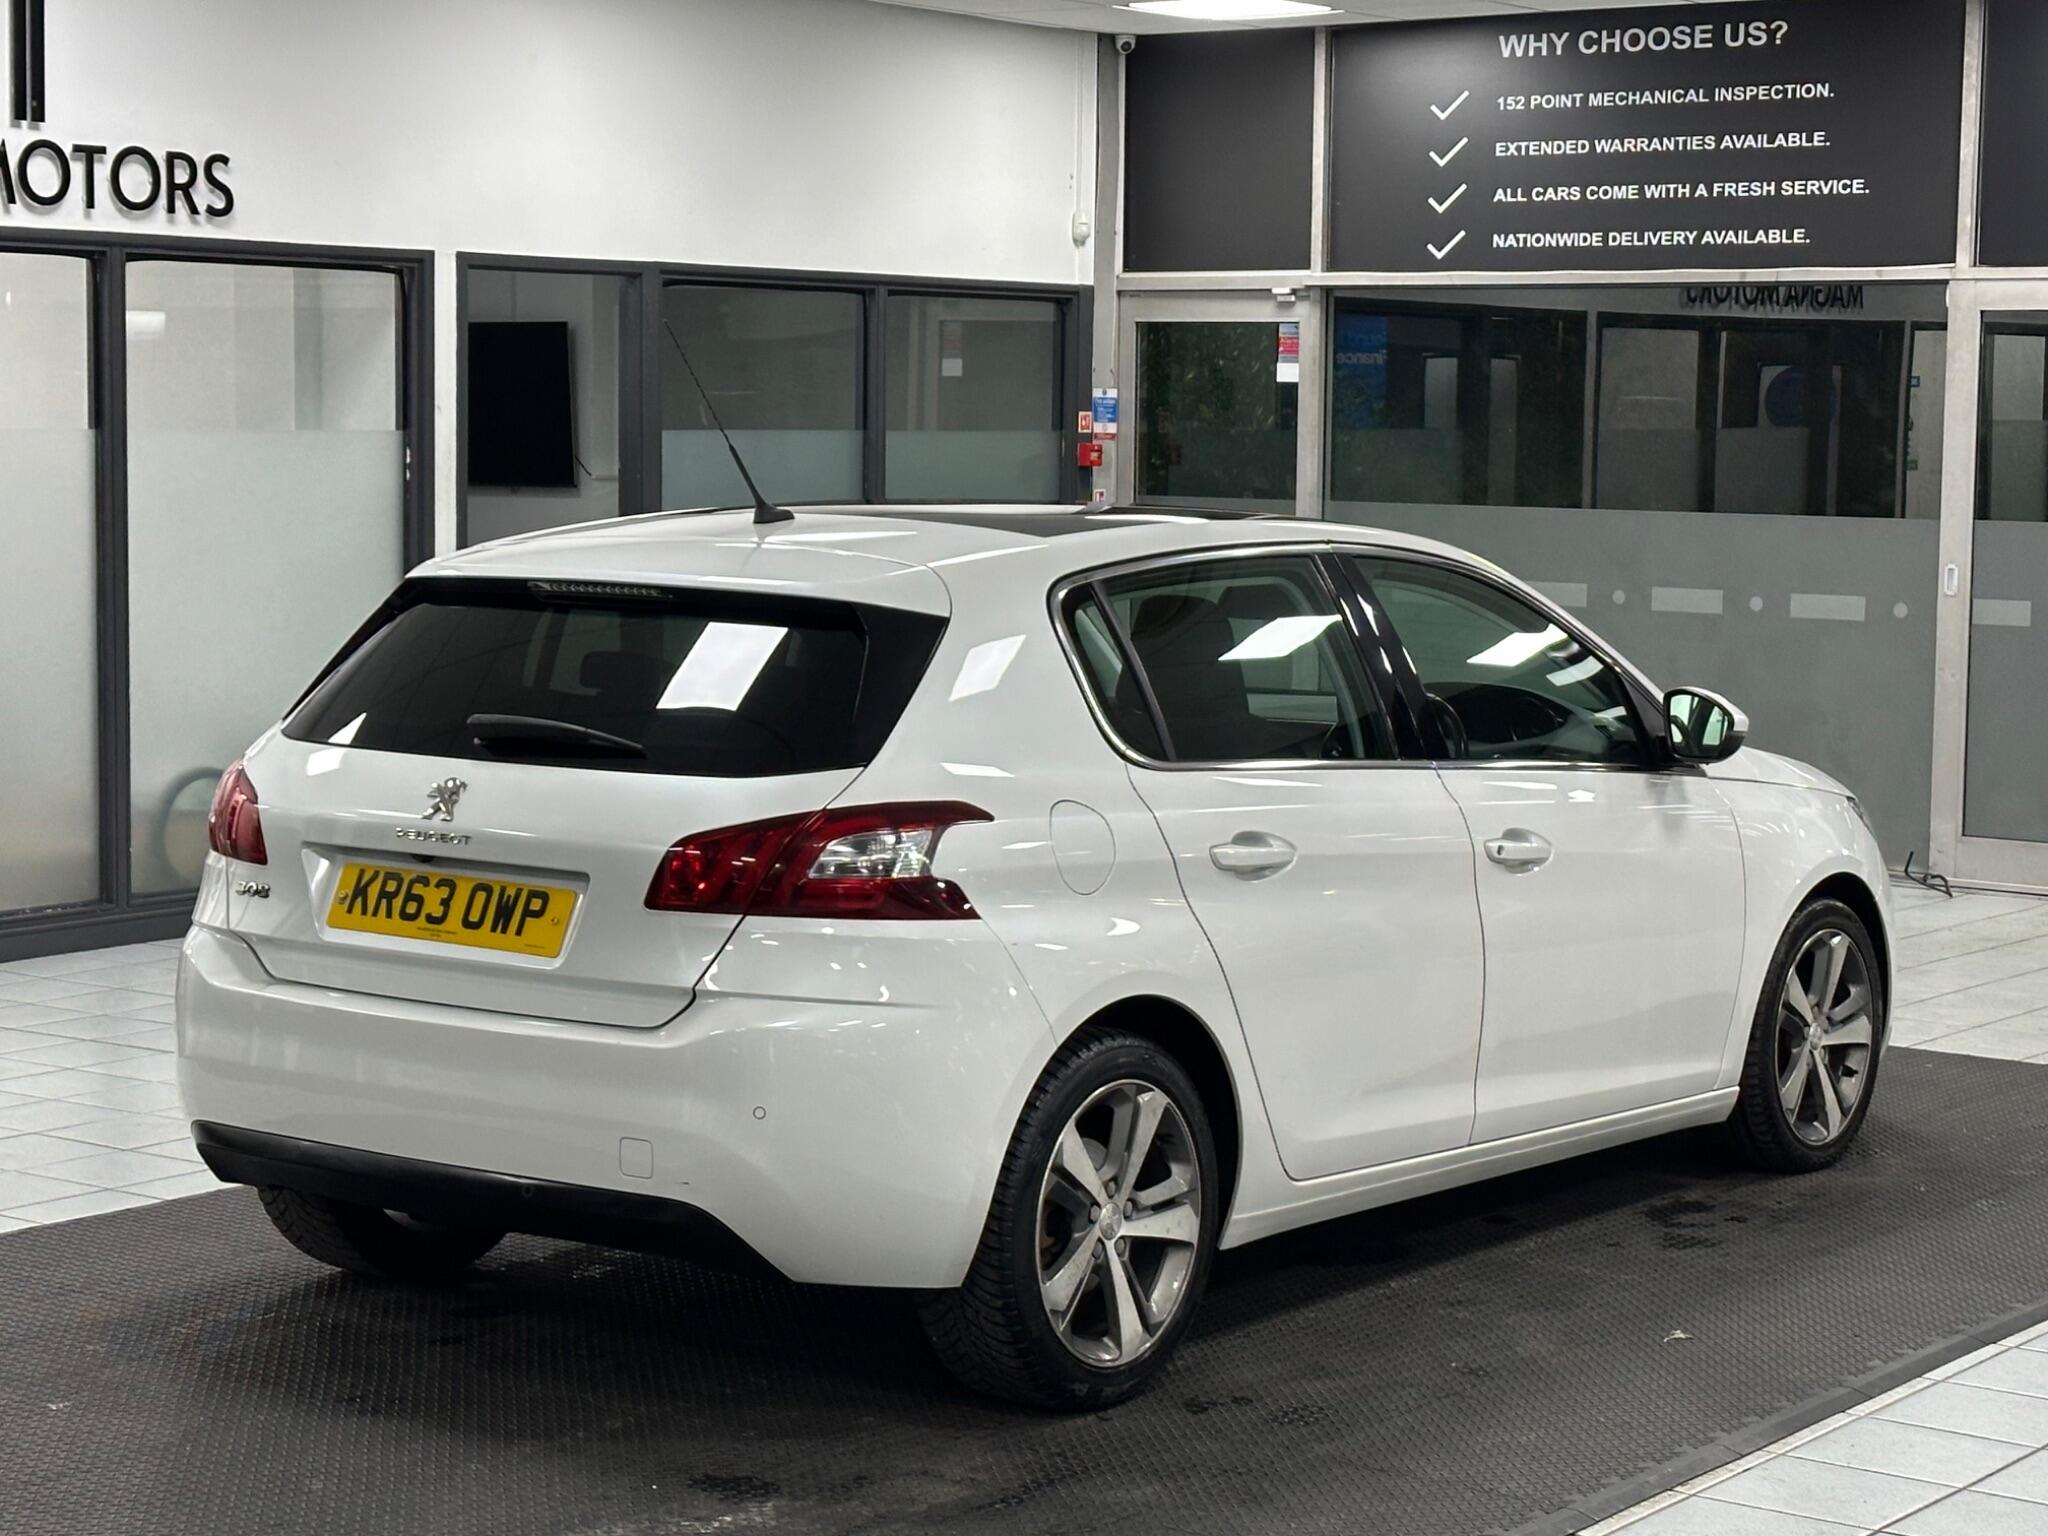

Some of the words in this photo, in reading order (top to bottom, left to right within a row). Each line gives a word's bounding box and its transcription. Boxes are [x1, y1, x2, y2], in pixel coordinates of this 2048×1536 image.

[1499, 32, 1571, 58] WHY
[1578, 24, 1713, 55] CHOOSE
[1724, 20, 1788, 47] US?
[1497, 96, 1525, 111] 152
[1530, 93, 1584, 110] POINT
[1588, 89, 1710, 108] MECHANICAL
[1714, 83, 1834, 102] INSPECTION.
[1495, 139, 1590, 157] EXTENDED
[1594, 136, 1716, 154] WARRANTIES
[1719, 132, 1830, 150] AVAILABLE.
[1493, 187, 1527, 203] ALL
[1531, 186, 1582, 202] CARS
[1586, 185, 1640, 201] COME
[1643, 184, 1691, 199] WITH
[1695, 184, 1709, 198] A
[1712, 182, 1776, 198] FRESH
[1780, 179, 1869, 196] SERVICE.
[1493, 232, 1604, 249] NATIONWIDE
[1608, 231, 1698, 247] DELIVERY
[1700, 229, 1810, 245] AVAILABLE.
[395, 827, 472, 846] PEUGEOT
[346, 868, 456, 926] KR63
[460, 882, 550, 937] OWP
